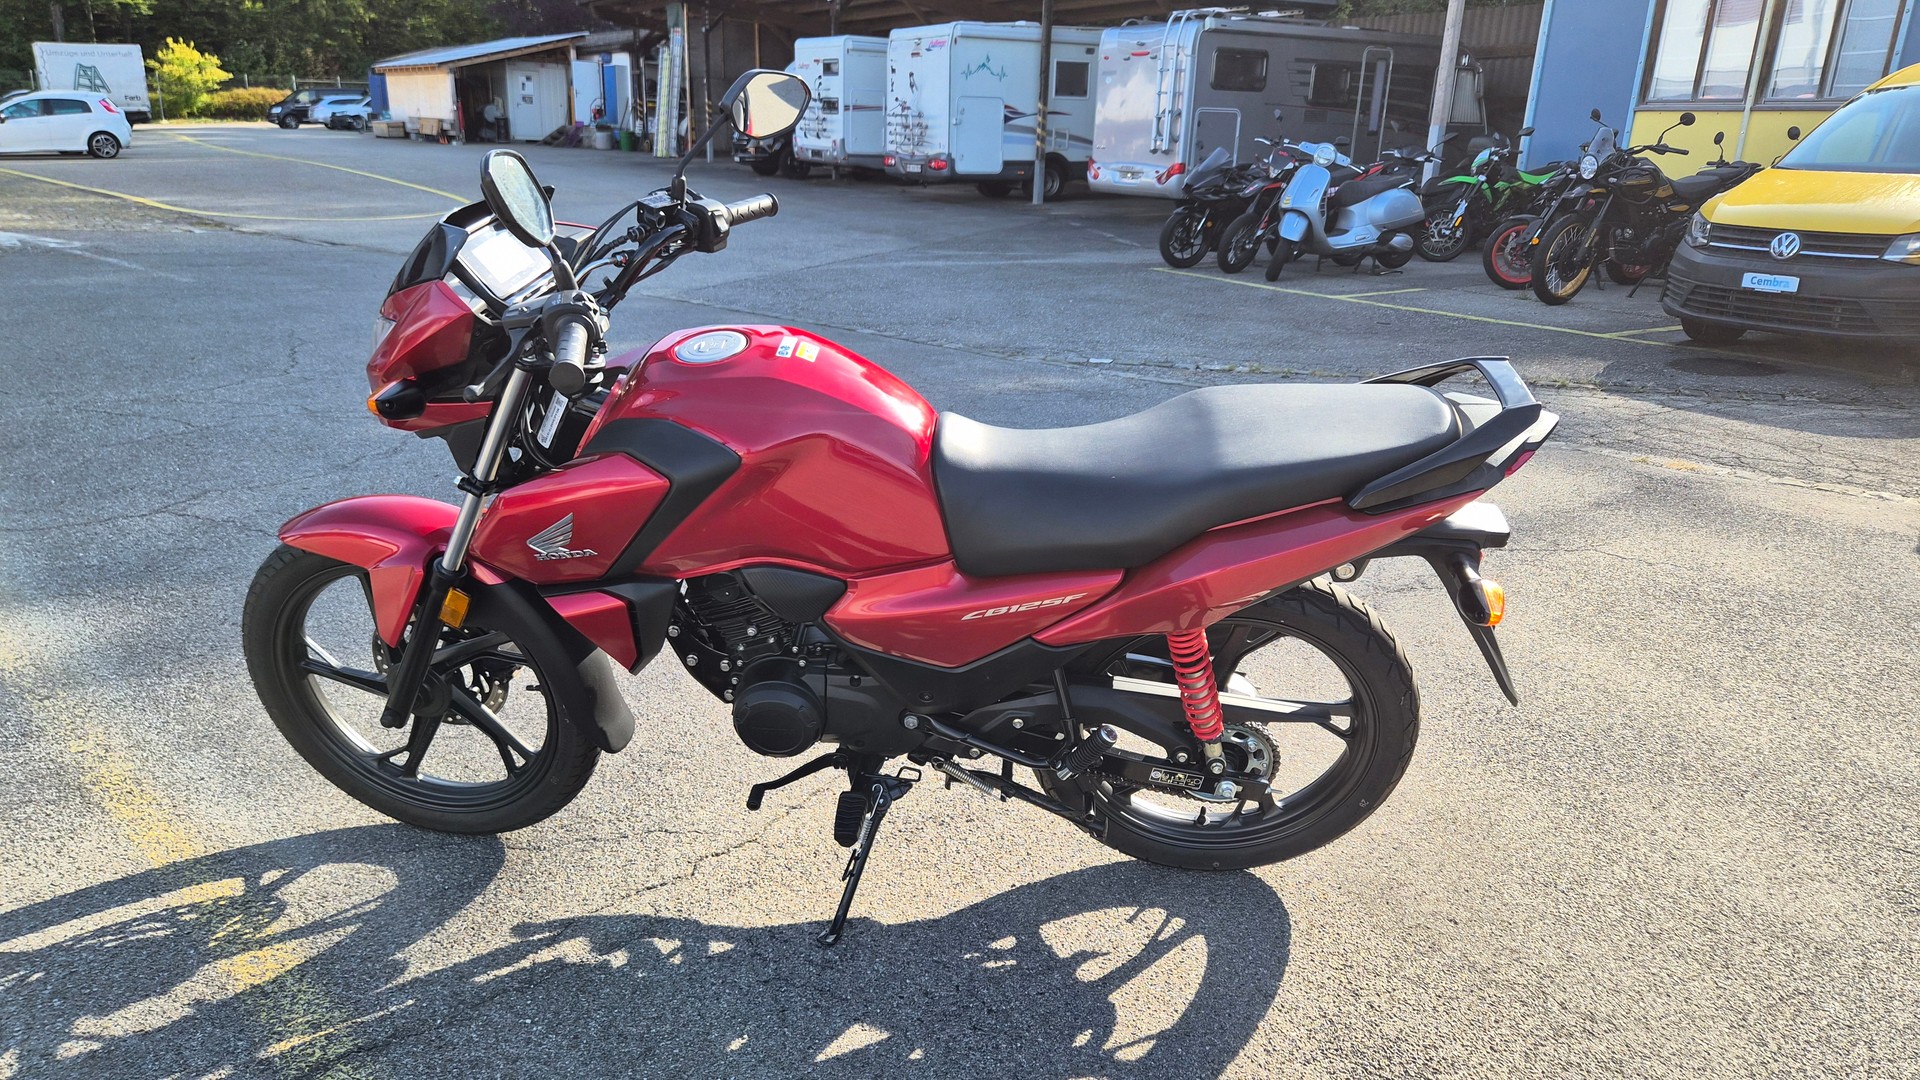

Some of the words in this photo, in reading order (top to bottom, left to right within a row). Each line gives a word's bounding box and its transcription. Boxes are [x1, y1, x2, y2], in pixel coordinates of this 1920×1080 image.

[80, 49, 95, 57] und
[1750, 276, 1790, 288] Cembra
[534, 549, 598, 561] HONDA
[961, 592, 1088, 621] CB125F
